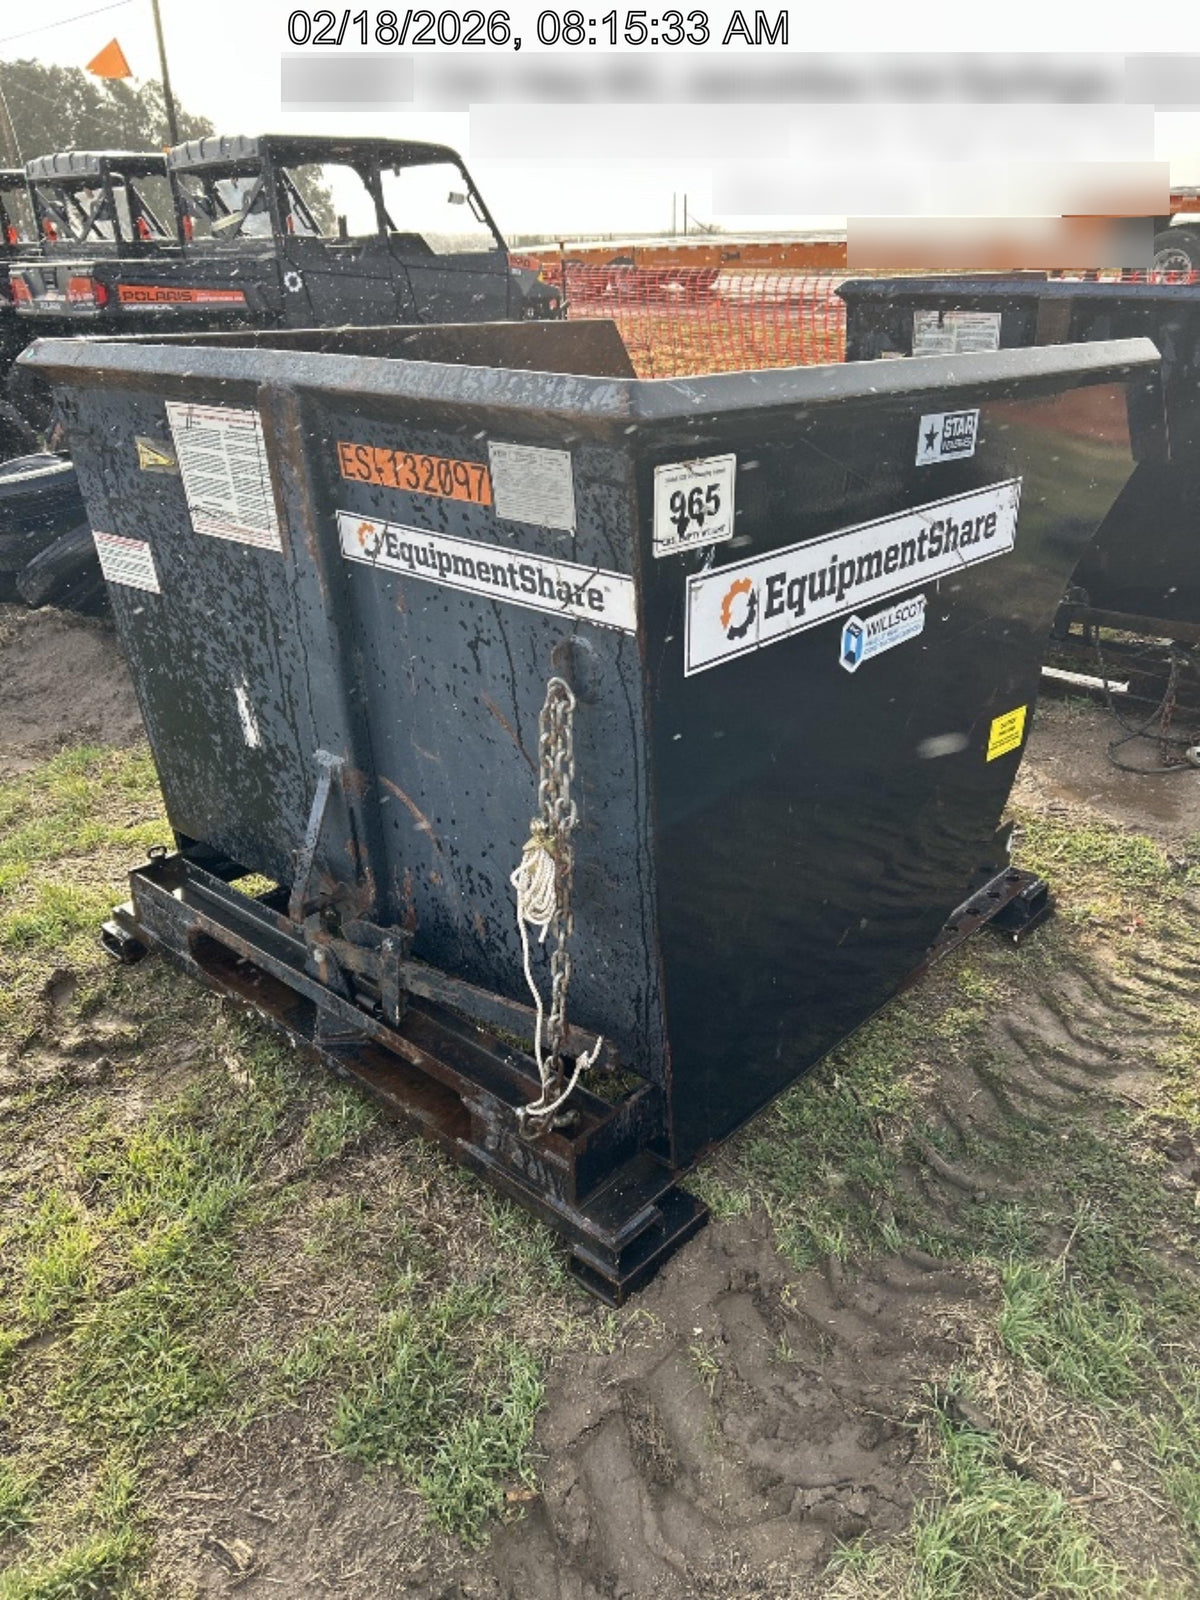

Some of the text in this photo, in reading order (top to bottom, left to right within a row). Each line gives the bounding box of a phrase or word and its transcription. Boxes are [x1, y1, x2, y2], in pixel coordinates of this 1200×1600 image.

[123, 291, 192, 301] POLARIS
[943, 415, 975, 438] STAR
[340, 444, 486, 502] ES-132097
[668, 482, 721, 523] 965
[386, 532, 605, 612] EquipmentShare
[763, 511, 998, 618] EquipmentShare
[866, 600, 924, 638] WILLSCOT
